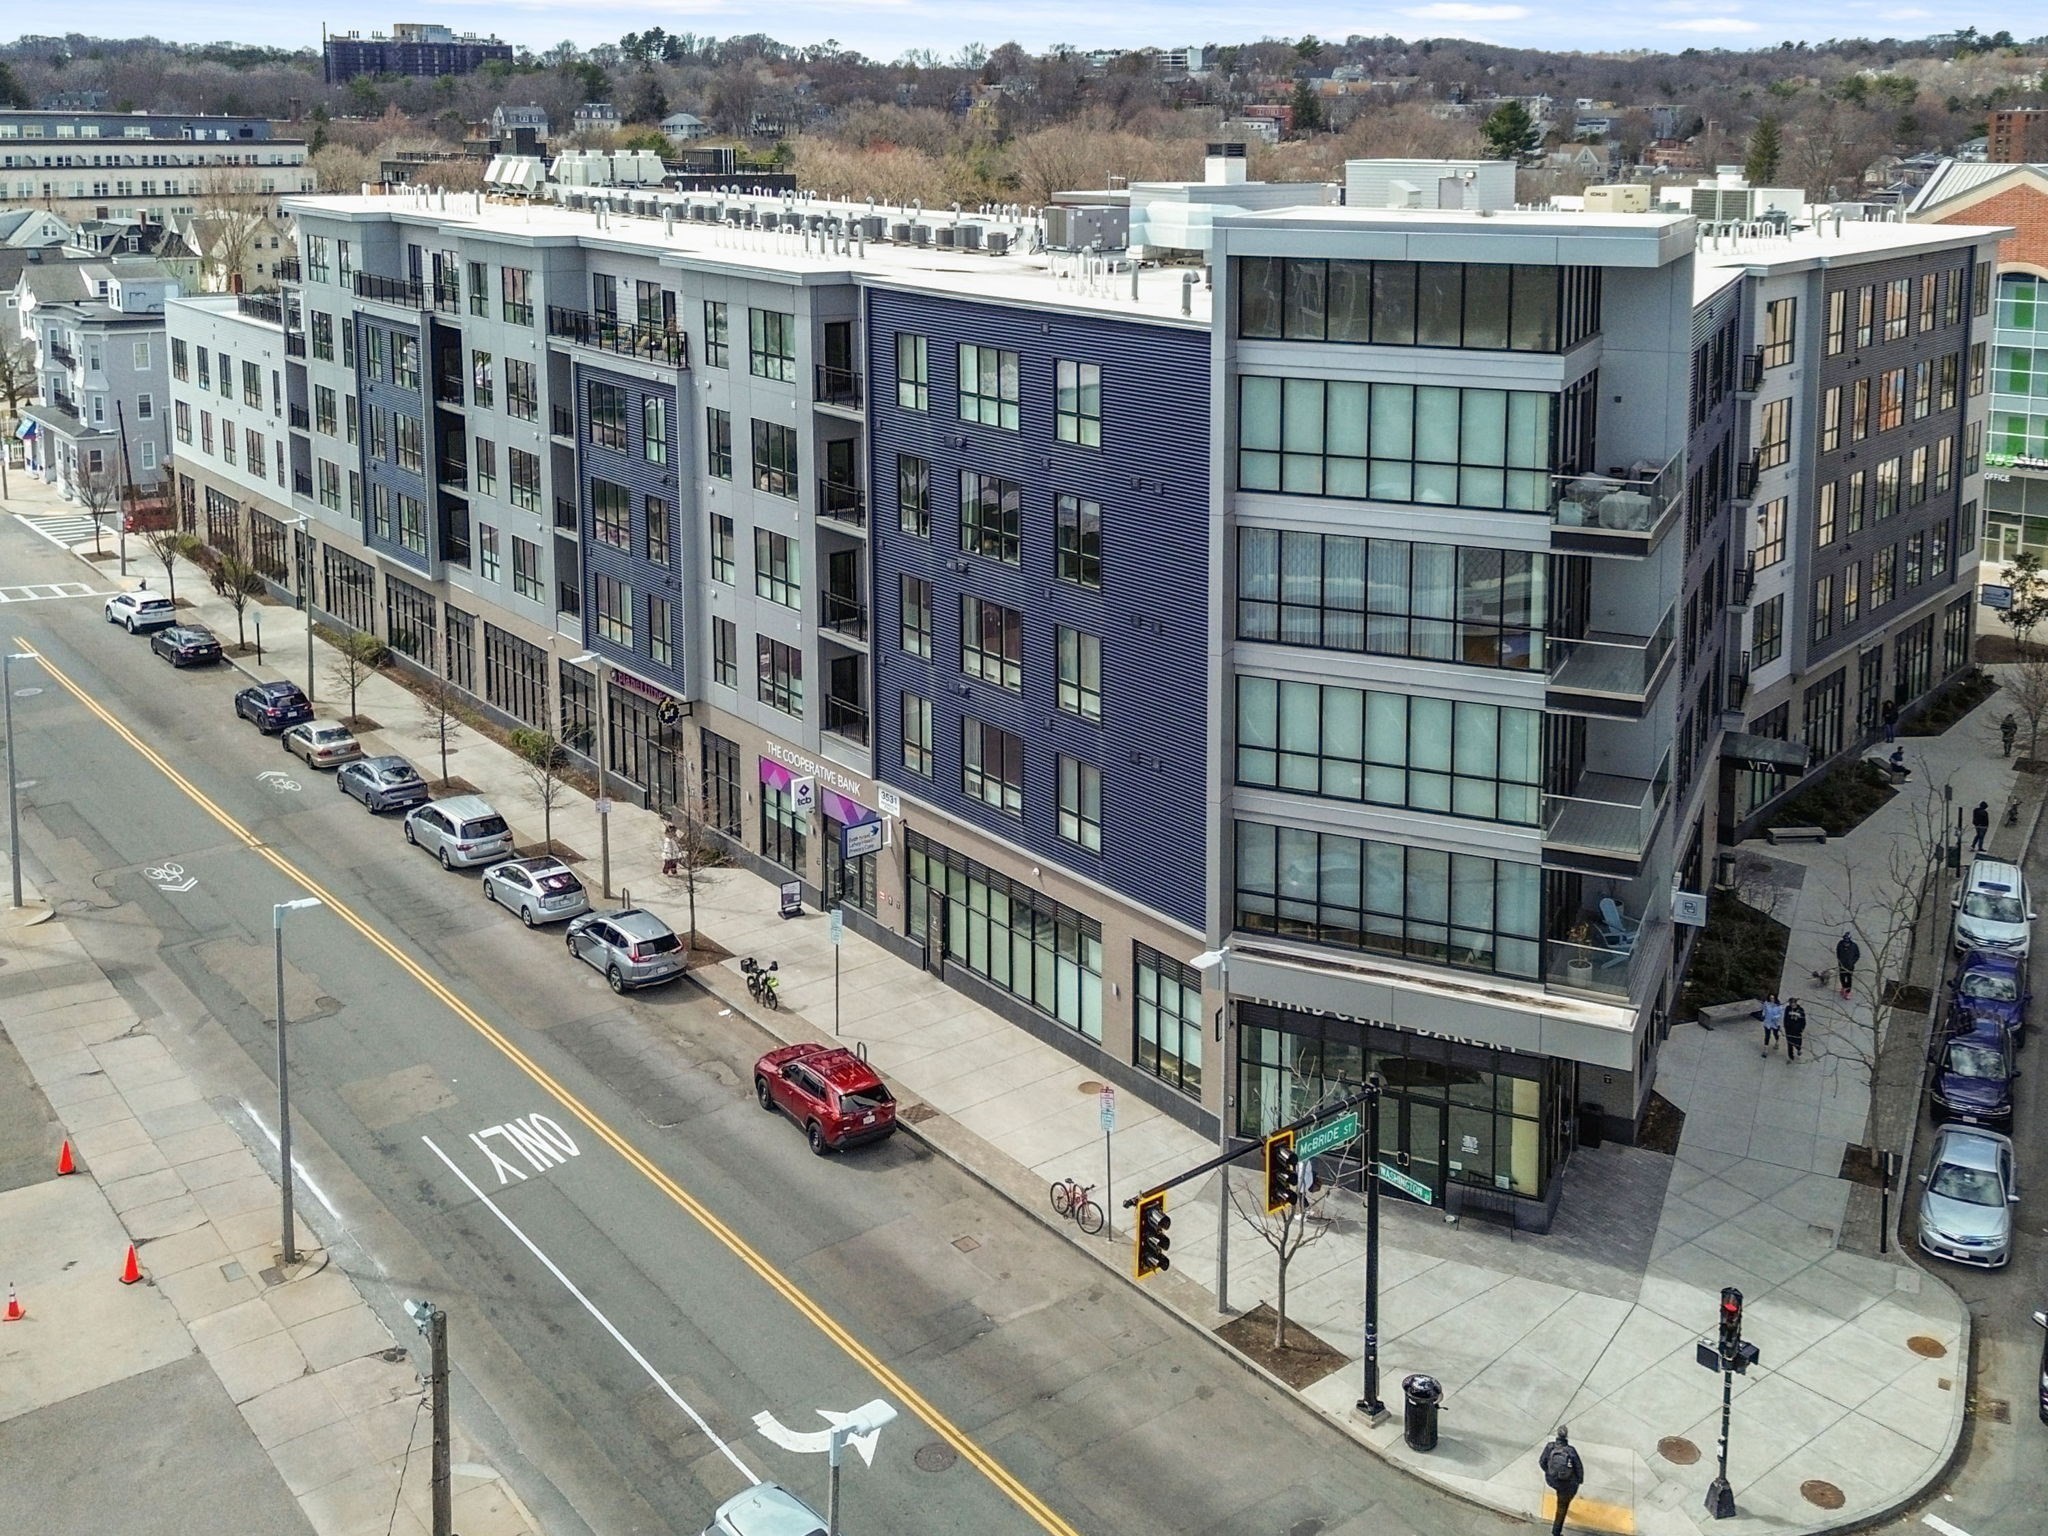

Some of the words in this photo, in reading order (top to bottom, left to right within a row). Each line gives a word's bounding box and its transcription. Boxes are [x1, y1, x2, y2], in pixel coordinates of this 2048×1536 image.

[766, 740, 781, 759] THE
[782, 749, 836, 785] COOPERATIVE
[837, 774, 860, 797] BANK
[797, 796, 812, 806] tcb
[881, 791, 897, 804] 3531
[468, 1112, 581, 1185] ONLY
[1299, 1126, 1340, 1155] McBRIDE
[1343, 1123, 1352, 1135] ST
[1380, 1166, 1423, 1195] WASHINGTON
